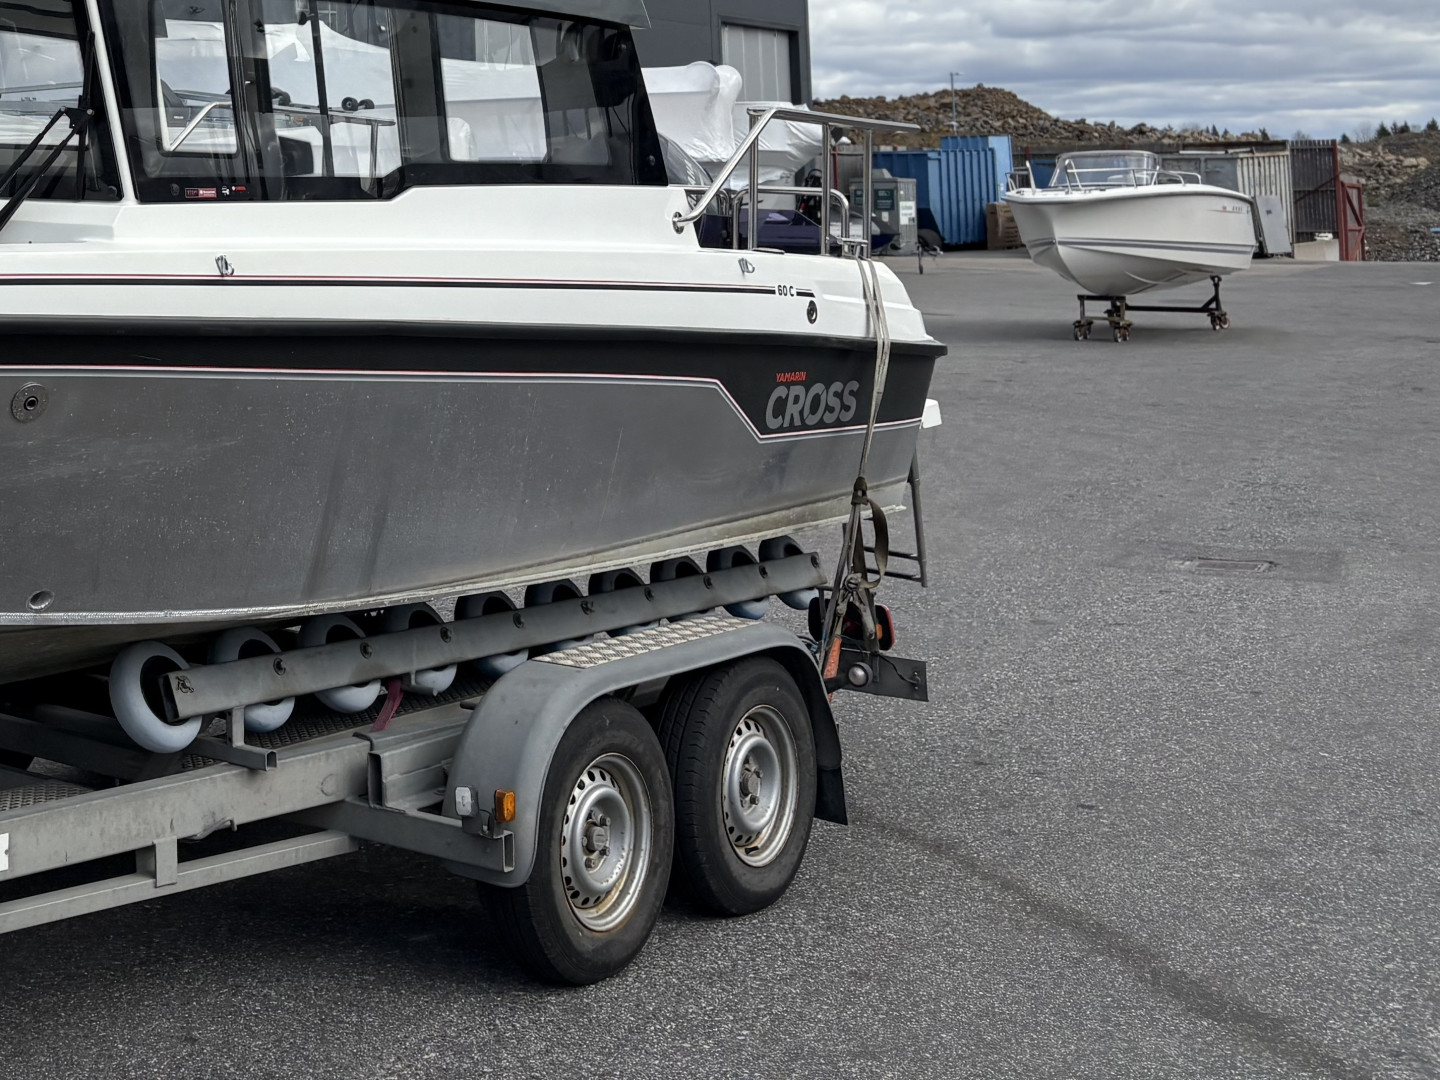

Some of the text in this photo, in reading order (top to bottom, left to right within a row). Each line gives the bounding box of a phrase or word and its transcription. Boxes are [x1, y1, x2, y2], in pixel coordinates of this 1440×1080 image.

[777, 285, 795, 297] 60 C
[776, 372, 807, 383] YAMARIN
[765, 380, 860, 429] CROSS
